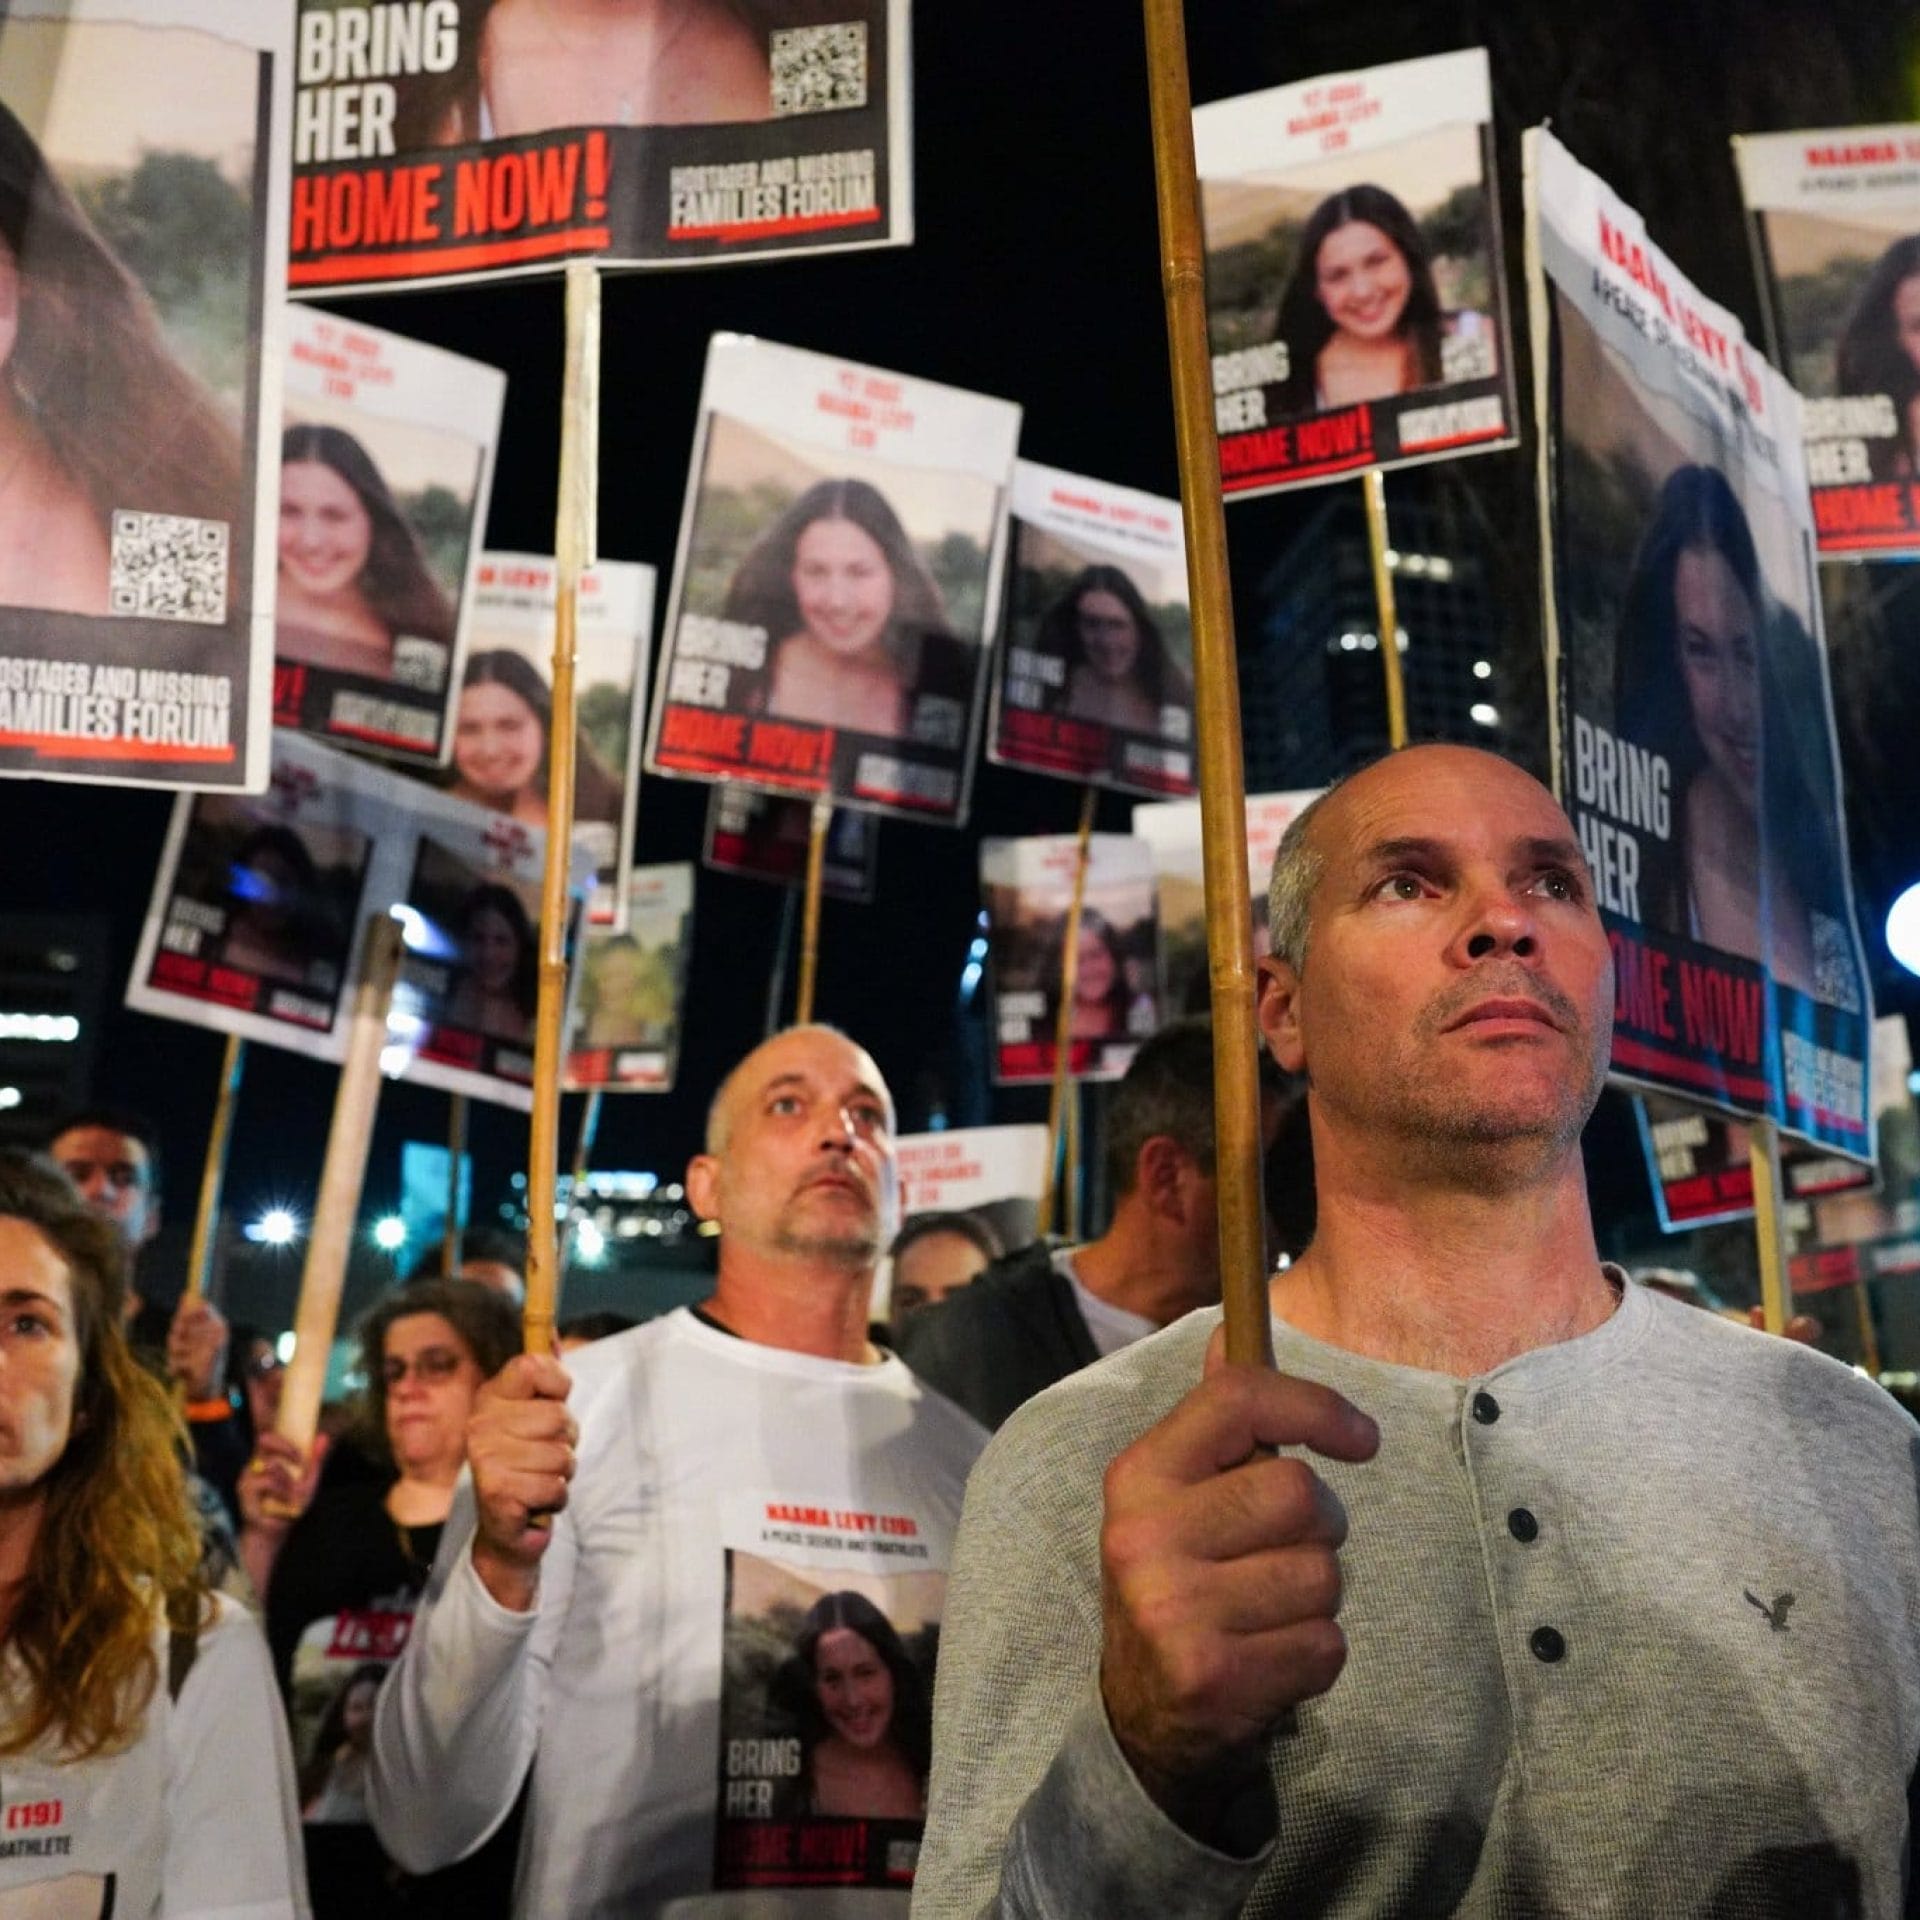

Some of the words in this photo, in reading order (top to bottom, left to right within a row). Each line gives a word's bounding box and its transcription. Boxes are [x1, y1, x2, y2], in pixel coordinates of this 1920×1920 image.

[300, 1, 459, 84] BRING
[296, 82, 396, 164] HER
[760, 157, 796, 186] AND
[1806, 141, 1897, 170] NAAMA
[291, 164, 443, 250] HOME
[454, 129, 610, 238] NOW!
[669, 184, 783, 229] FAMILIES
[785, 175, 876, 219] FORUM
[1211, 340, 1291, 396] BRING
[1214, 388, 1268, 435] HER
[1217, 425, 1291, 477] HOME
[1297, 402, 1375, 462] NOW!
[1804, 439, 1872, 487] HER
[1811, 482, 1905, 534] HOME
[676, 612, 769, 671] BRING
[0, 657, 91, 697] OSTAGES
[92, 664, 136, 701] AND
[138, 669, 231, 709] MISSING
[669, 656, 731, 708] HER
[0, 689, 118, 741] AMILIES
[122, 699, 231, 748] FORUM
[661, 703, 748, 761] HOME
[748, 720, 837, 778] NOW!
[1573, 715, 1672, 842] BRING
[1578, 810, 1641, 924] HER
[1611, 928, 1677, 1040] OME
[1679, 960, 1761, 1066] NOW
[766, 1504, 831, 1527] NAAMA
[834, 1510, 878, 1533] LEVY
[727, 1737, 801, 1777] BRING
[6, 1799, 63, 1829] (19)
[726, 1779, 773, 1819] HER
